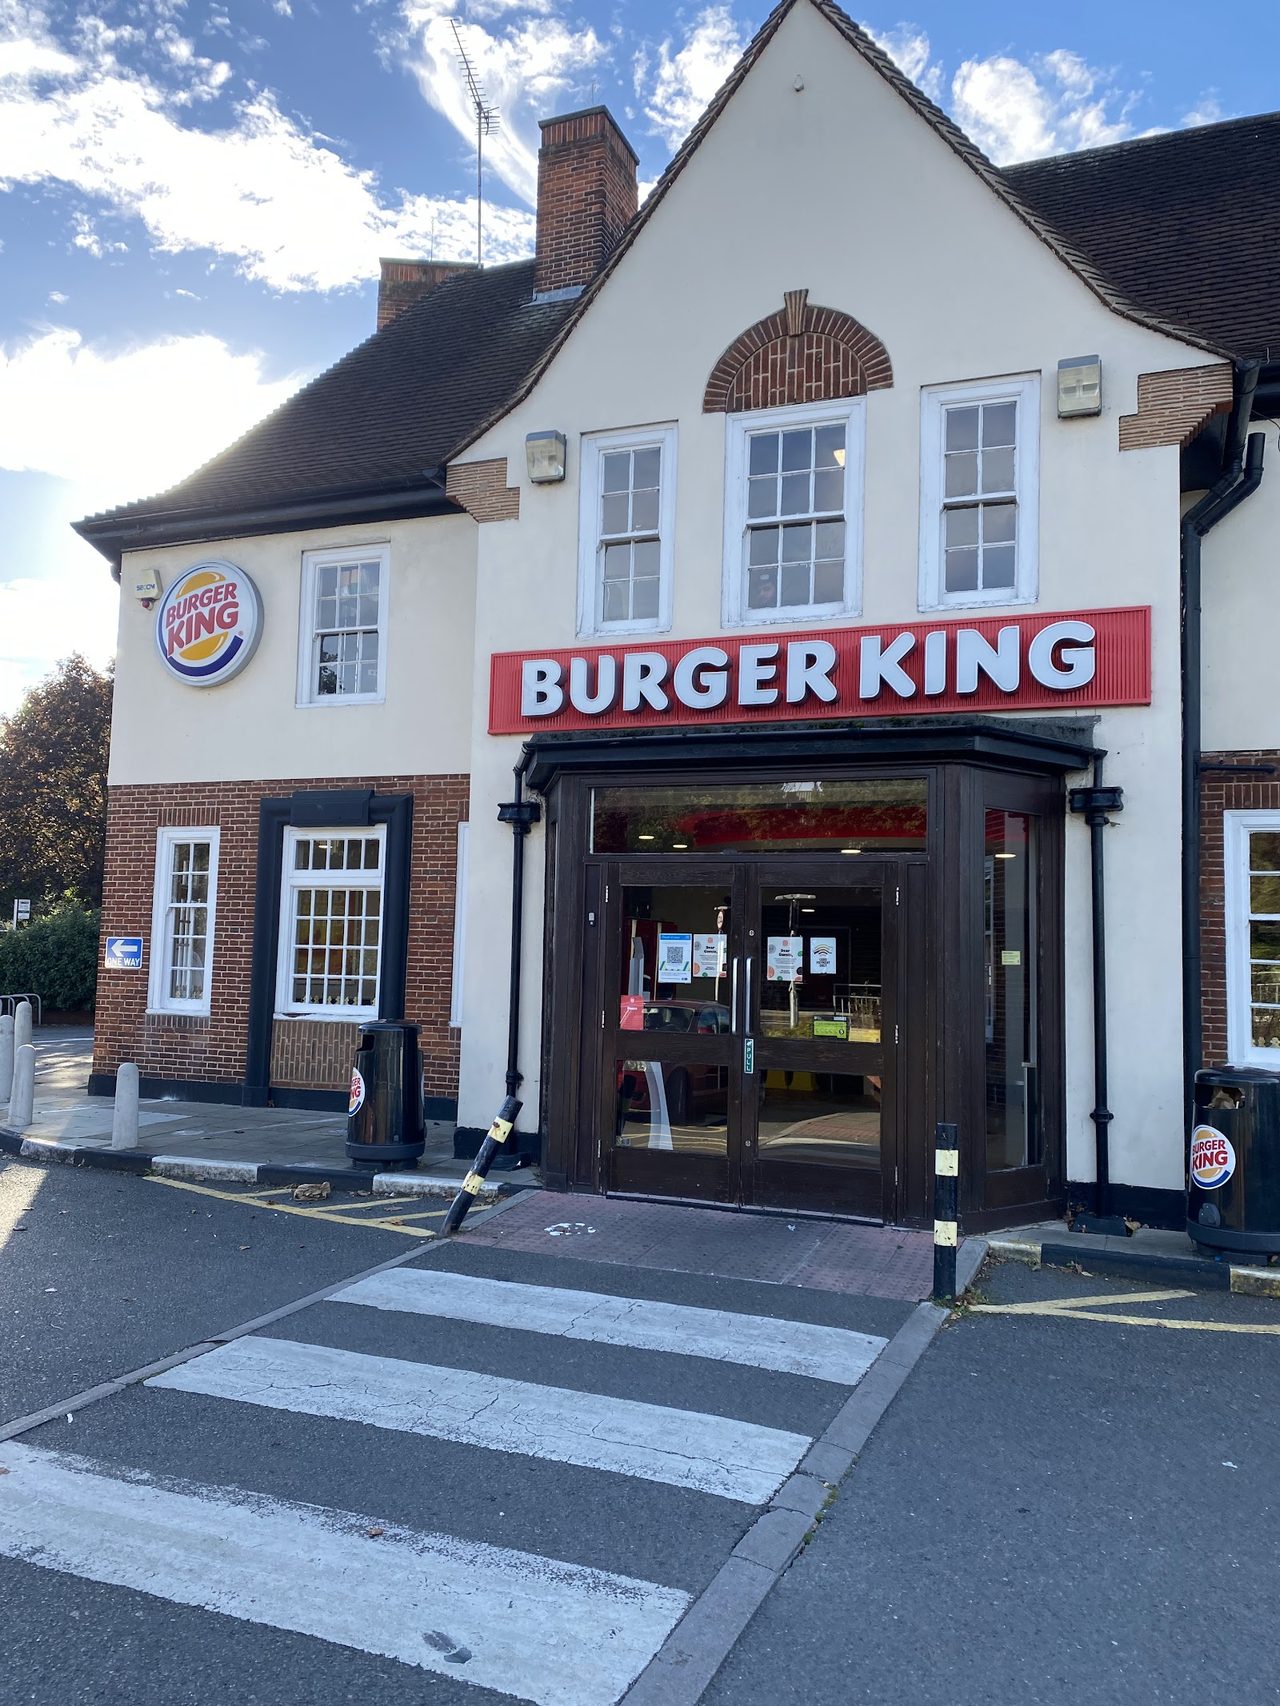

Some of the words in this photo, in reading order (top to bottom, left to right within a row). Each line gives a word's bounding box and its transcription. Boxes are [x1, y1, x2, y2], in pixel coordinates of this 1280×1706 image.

[166, 582, 237, 629] BURGER
[167, 601, 239, 657] KING
[520, 638, 840, 718] BURGER
[859, 620, 1096, 700] KING
[107, 957, 122, 966] ONE
[123, 957, 140, 967] WAY
[1193, 1139, 1226, 1155] BURGER
[1193, 1150, 1228, 1170] KING
